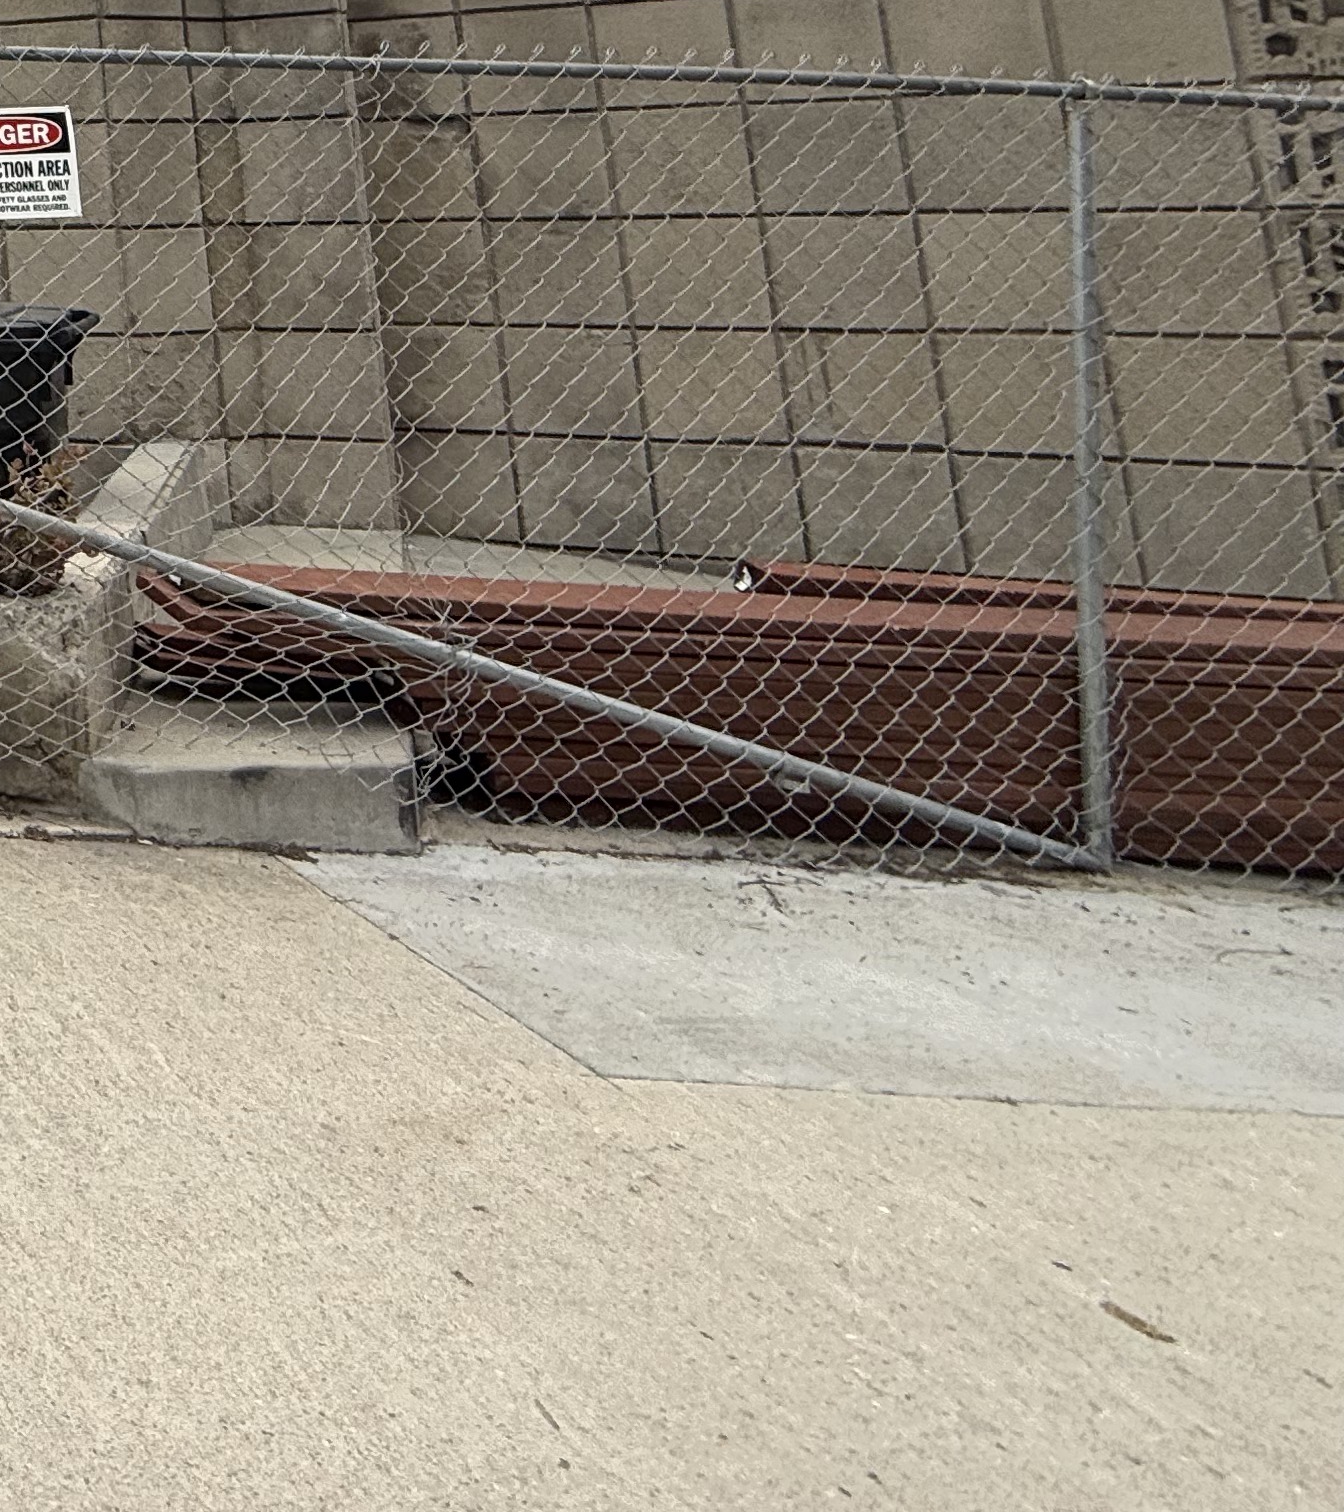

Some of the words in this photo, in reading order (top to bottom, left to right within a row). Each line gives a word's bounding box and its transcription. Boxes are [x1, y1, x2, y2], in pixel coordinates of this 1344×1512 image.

[38, 159, 71, 177] AREA
[47, 179, 70, 191] ONLY
[17, 195, 50, 203] GLASSES
